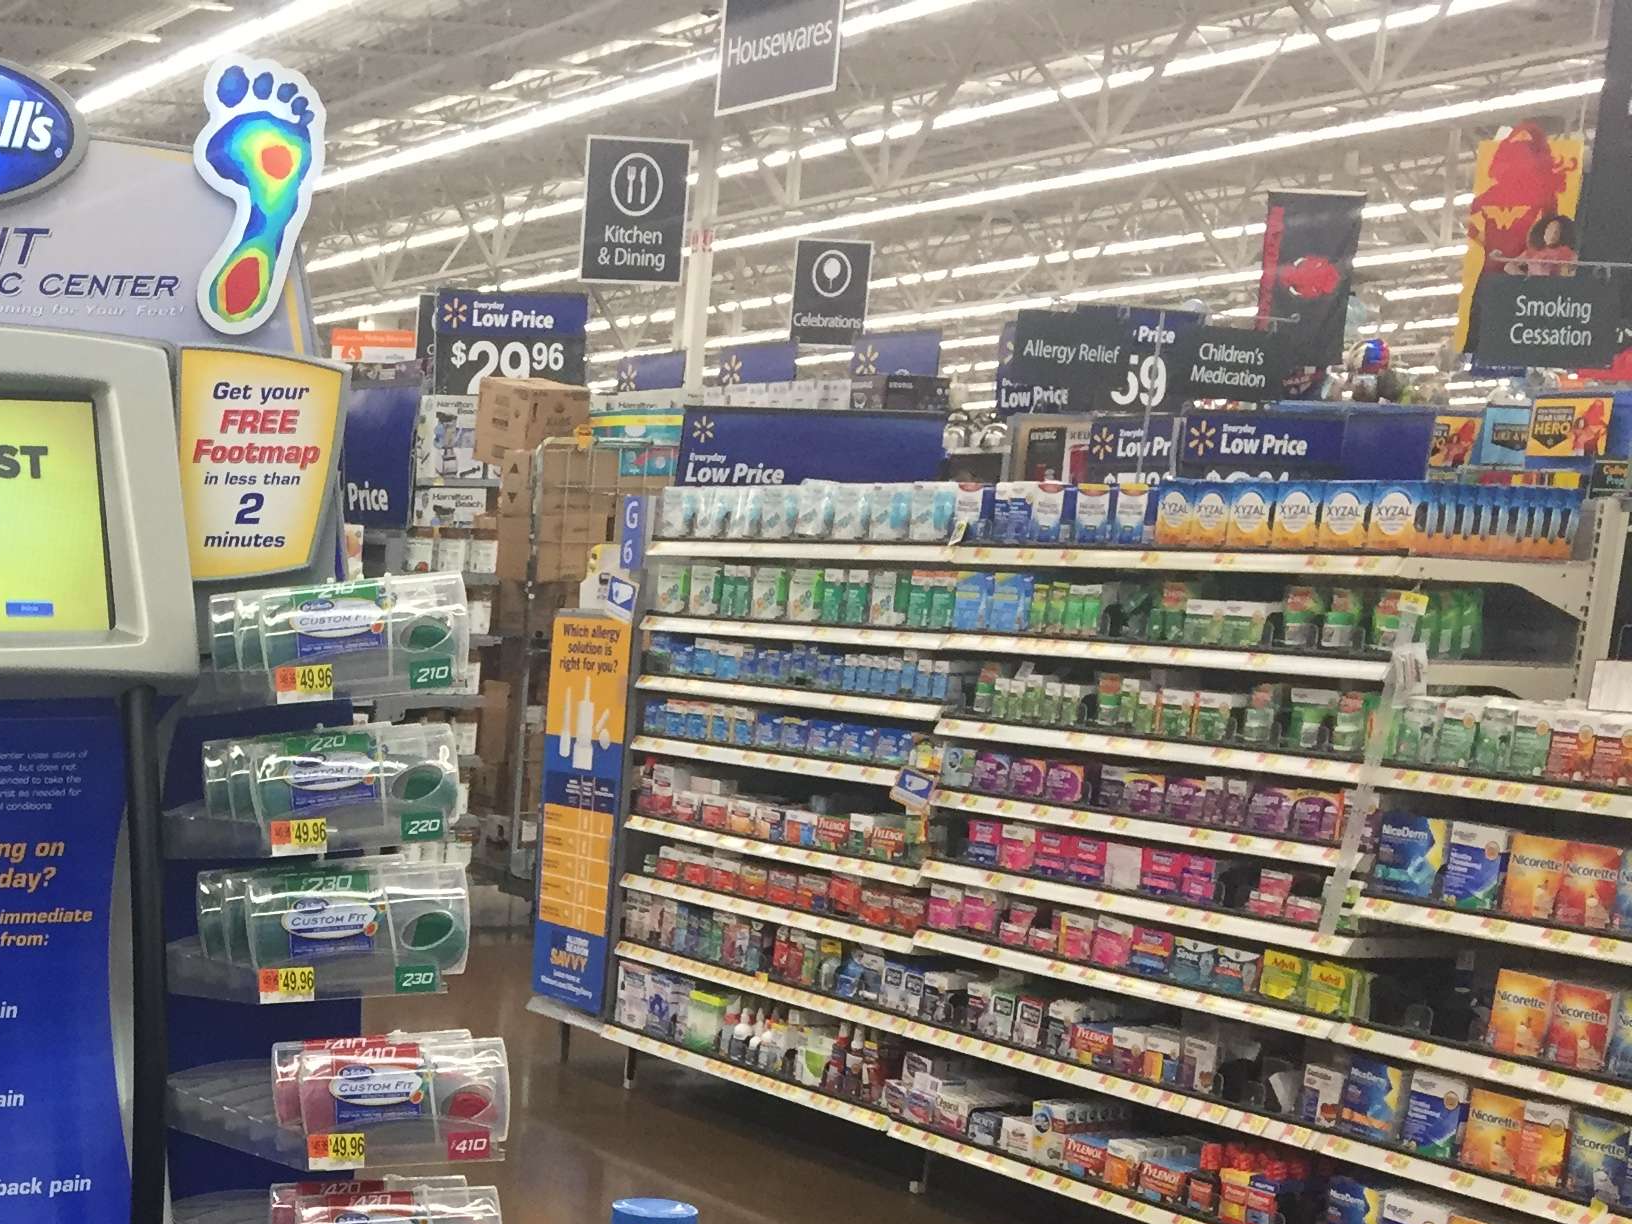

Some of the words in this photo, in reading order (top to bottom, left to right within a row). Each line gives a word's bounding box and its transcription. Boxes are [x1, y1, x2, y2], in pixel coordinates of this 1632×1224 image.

[727, 20, 833, 67] Housewares
[604, 225, 662, 245] Kitchen
[598, 250, 610, 265] &
[614, 247, 665, 271] Dining
[39, 273, 180, 299] CENTER
[473, 301, 504, 310] Everyday
[1515, 295, 1592, 322] Smoking
[473, 310, 509, 327] Low
[512, 310, 554, 329] Price
[793, 312, 862, 329] Celebrations
[1138, 325, 1175, 344] Price
[1510, 323, 1592, 346] Cessation
[1023, 339, 1076, 364] Allergy
[1079, 344, 1120, 364] Relief
[1198, 343, 1264, 365] Children's
[1190, 364, 1266, 389] Medication
[213, 382, 253, 400] Get
[261, 386, 310, 405] your
[220, 409, 300, 434] FREE
[1534, 422, 1570, 434] HERO
[193, 439, 321, 470] Footmap
[1220, 434, 1261, 456] Low
[1262, 434, 1307, 456] Price
[689, 453, 727, 464] Everyday
[204, 472, 218, 485] in
[225, 472, 256, 485] less
[263, 472, 300, 485] than
[685, 463, 729, 484] Low
[734, 463, 784, 485] Price
[348, 482, 389, 511] Price
[235, 493, 264, 525] 2
[625, 501, 638, 528] G
[1161, 501, 1189, 517] XYZAL
[1197, 501, 1225, 517] XYZAL
[1232, 502, 1266, 518] XYZAL
[204, 531, 285, 548] minutes
[623, 538, 633, 563] 6
[564, 624, 588, 637] Which
[592, 625, 620, 643] allergy
[568, 642, 603, 654] solution
[605, 645, 612, 655] is
[417, 667, 448, 682] 210
[560, 656, 579, 672] right
[583, 657, 595, 670] for
[597, 660, 618, 675] you?
[408, 819, 440, 834] 220
[1382, 824, 1428, 840] NicoDerm
[35, 840, 65, 857] on
[1512, 853, 1562, 871] Nicorette
[1567, 863, 1616, 880] Nicorette
[0, 909, 93, 925] immediate
[0, 933, 49, 949] from:
[402, 972, 434, 987] 230
[1497, 990, 1546, 1009] Nicorette
[49, 1175, 91, 1197] pain
